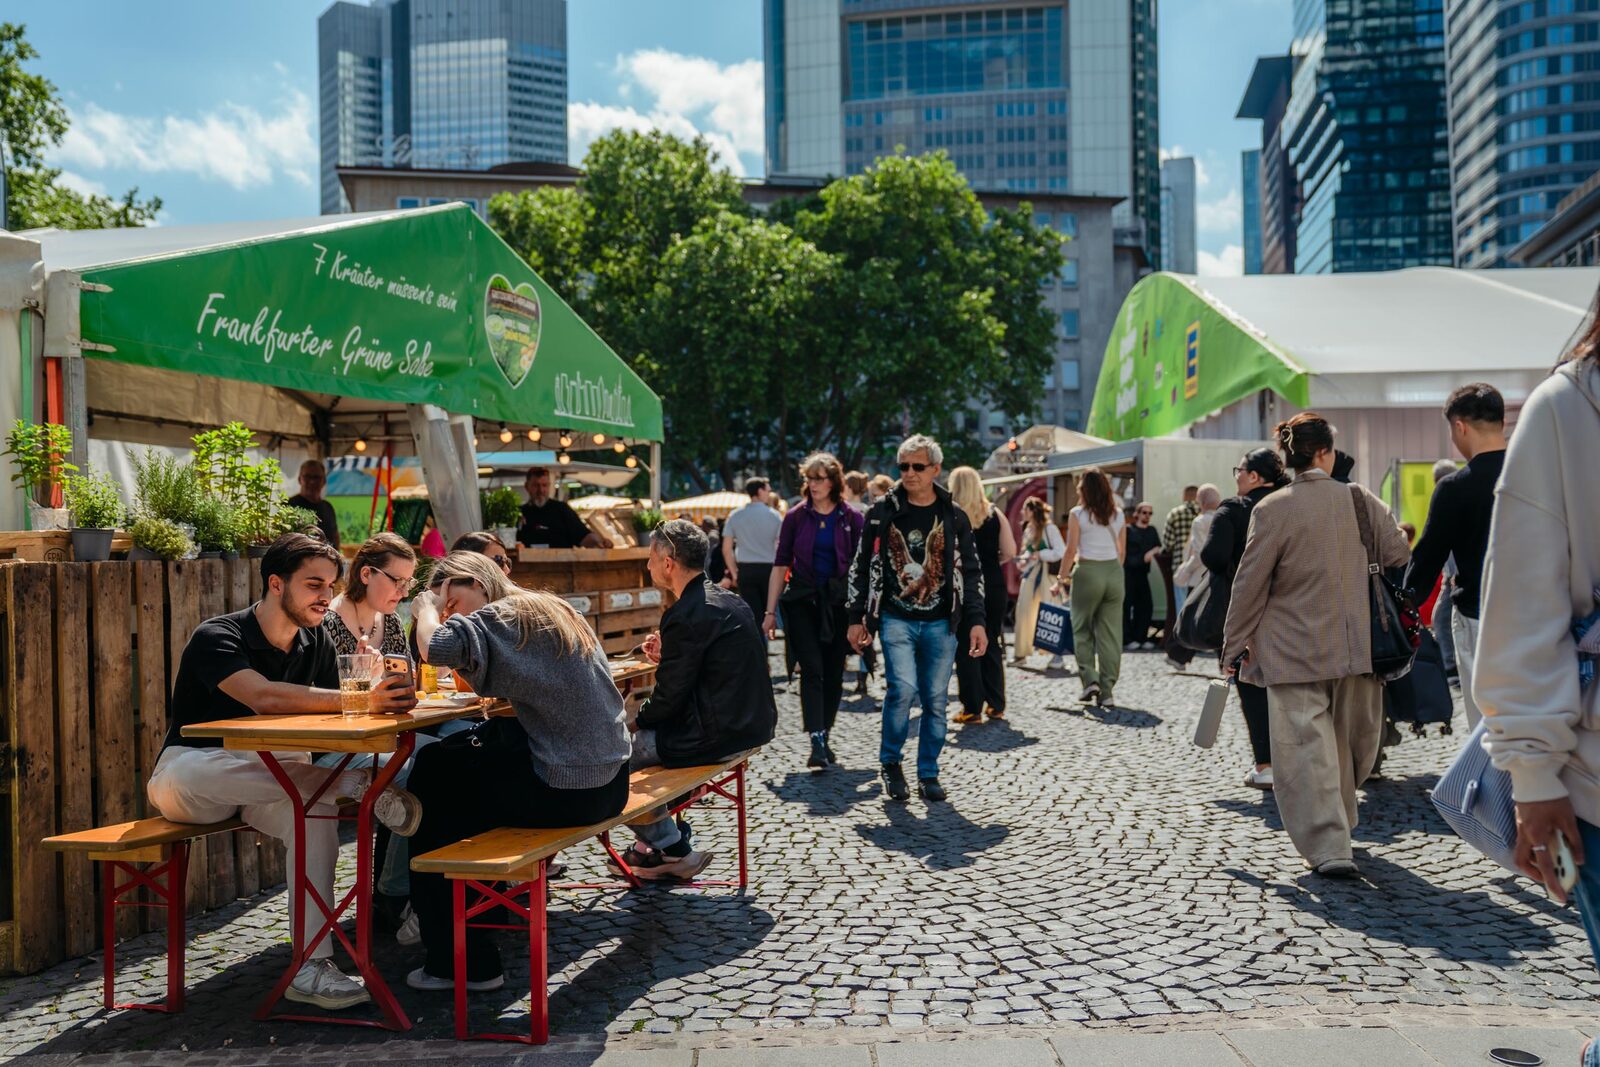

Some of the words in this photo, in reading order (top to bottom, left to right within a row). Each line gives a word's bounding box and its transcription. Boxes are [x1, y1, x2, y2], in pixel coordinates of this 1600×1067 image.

[312, 242, 327, 275] 7
[329, 250, 383, 290] Kräuter
[387, 276, 434, 304] müssen's
[436, 291, 458, 312] sein
[197, 293, 333, 363] Frankfurter
[341, 325, 393, 376] Grüne
[1040, 609, 1064, 627] 1901
